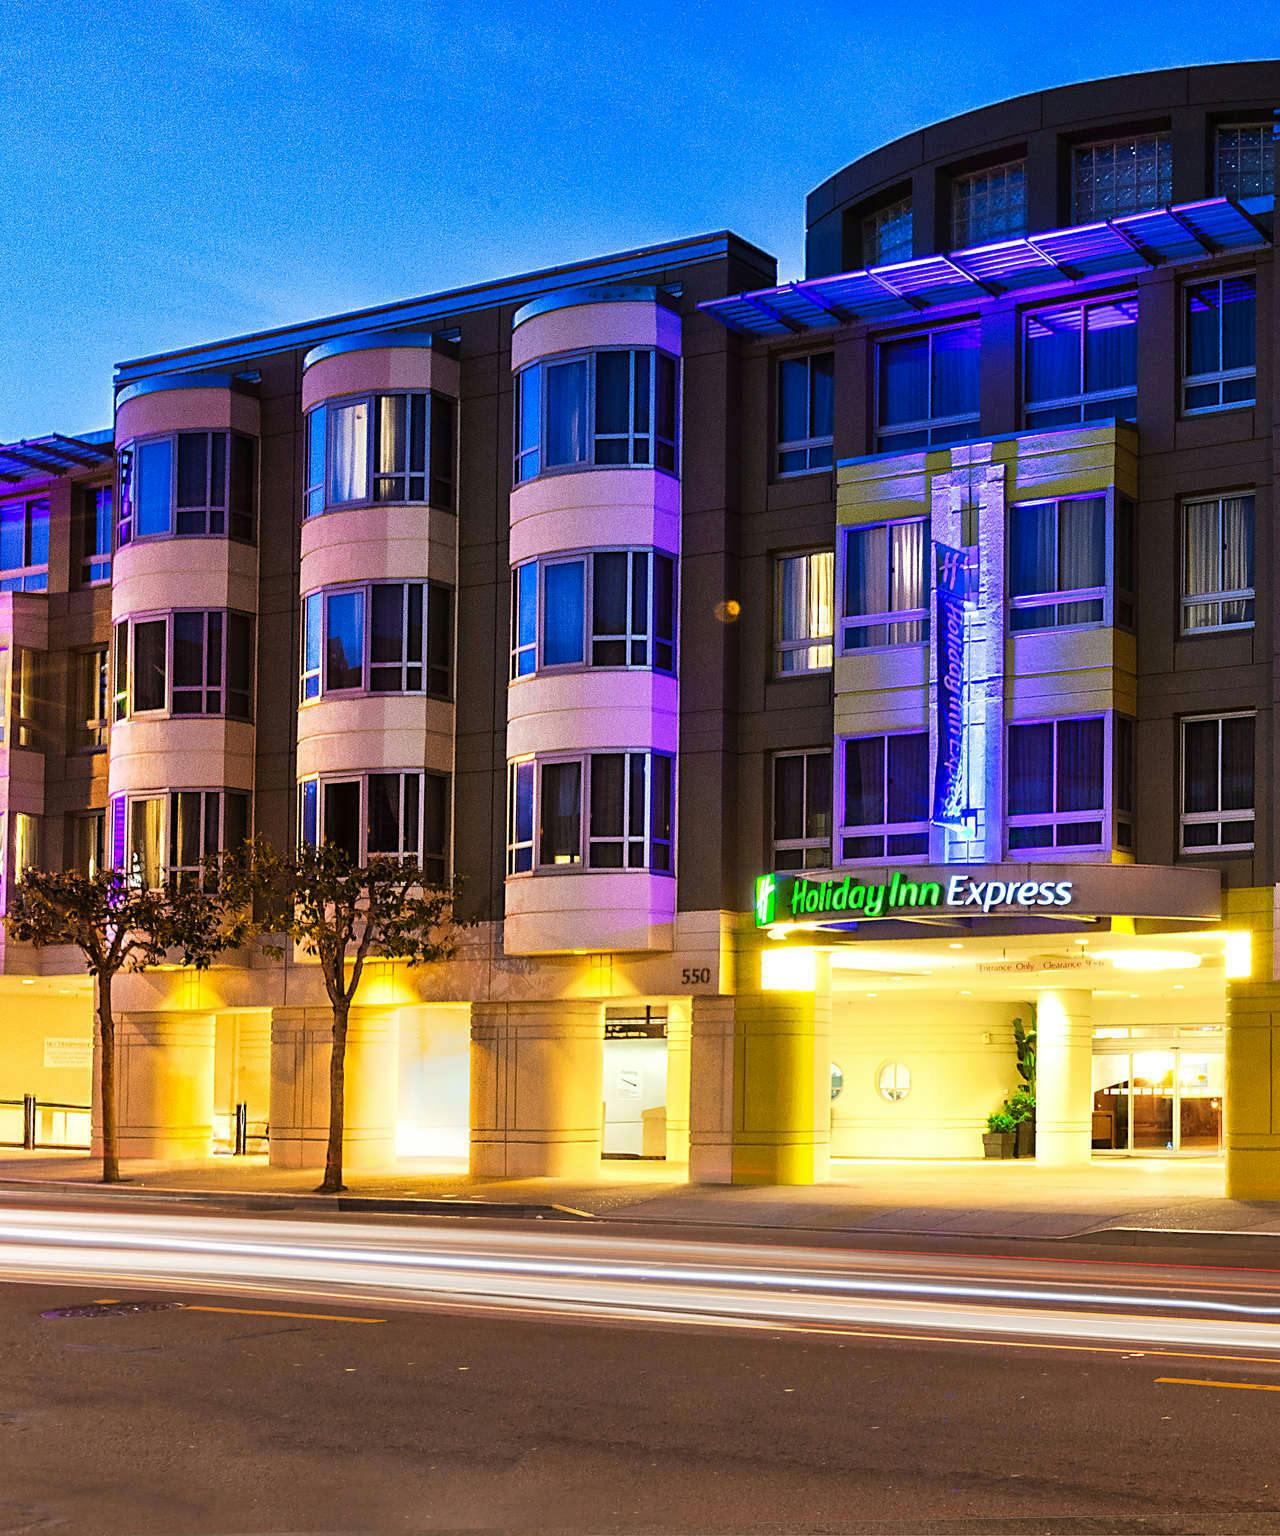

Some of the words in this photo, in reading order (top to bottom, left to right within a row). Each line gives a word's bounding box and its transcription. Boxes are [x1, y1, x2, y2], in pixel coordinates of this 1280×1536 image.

[944, 602, 964, 692] Holiday
[948, 696, 963, 735] Inn
[943, 738, 963, 818] Expres
[792, 874, 885, 917] Holiday
[889, 871, 942, 909] Inn
[946, 875, 1073, 914] Express
[681, 968, 711, 985] 550
[980, 963, 1012, 973] Entrance
[1015, 962, 1034, 972] Only
[1043, 960, 1082, 970] Clearance
